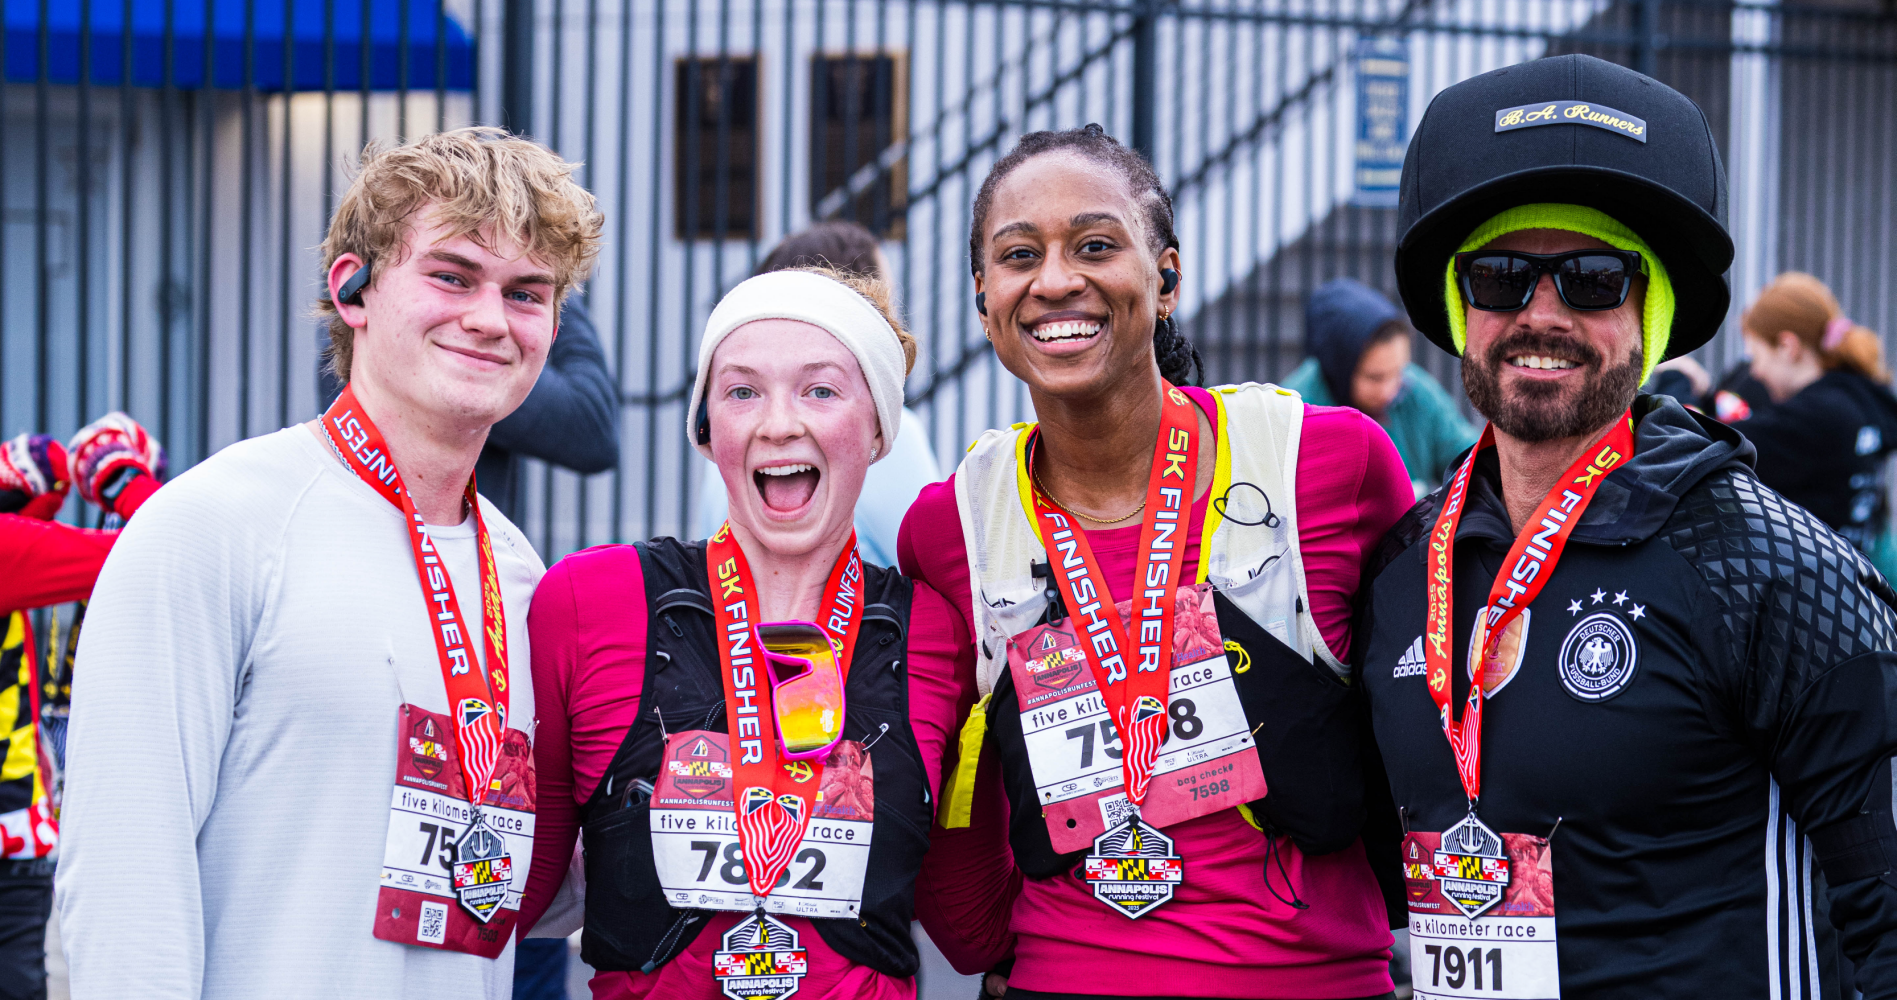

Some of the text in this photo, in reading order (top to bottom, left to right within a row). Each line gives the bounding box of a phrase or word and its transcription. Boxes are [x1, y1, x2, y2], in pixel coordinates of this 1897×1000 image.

[1499, 104, 1643, 136] B.A. Runners
[1573, 445, 1623, 489] 5K
[1137, 426, 1190, 676] 5K FINISHER
[402, 508, 471, 678] INISHER
[826, 541, 860, 636] RUNFEST
[1043, 511, 1129, 687] FINISHER
[1428, 518, 1454, 660] Annapolis
[1579, 623, 1621, 642] DEUTSCHER
[717, 555, 764, 767] 5K FINISHER
[1036, 664, 1079, 682] ANNAPOLIS
[1393, 660, 1428, 679] adidas
[1568, 663, 1621, 689] FUSSBALL-BUND
[1032, 707, 1068, 728] five
[1173, 668, 1213, 689] race
[1186, 752, 1209, 763] ULTRA
[1177, 776, 1197, 787] bag
[1189, 778, 1231, 802] 7598
[402, 792, 427, 811] five
[492, 814, 523, 832] race
[661, 814, 696, 830] five
[813, 826, 855, 841] race
[690, 840, 827, 891] 782
[1100, 884, 1168, 895] ANNAPOLIS
[1108, 894, 1135, 902] running
[1445, 881, 1498, 896] ANNAPOLIS
[1451, 892, 1472, 901] running
[1425, 918, 1490, 937] kilometer
[1497, 922, 1536, 938] race
[1425, 944, 1503, 992] 7911
[728, 977, 794, 990] ANNAPOLIS
[736, 988, 761, 996] running
